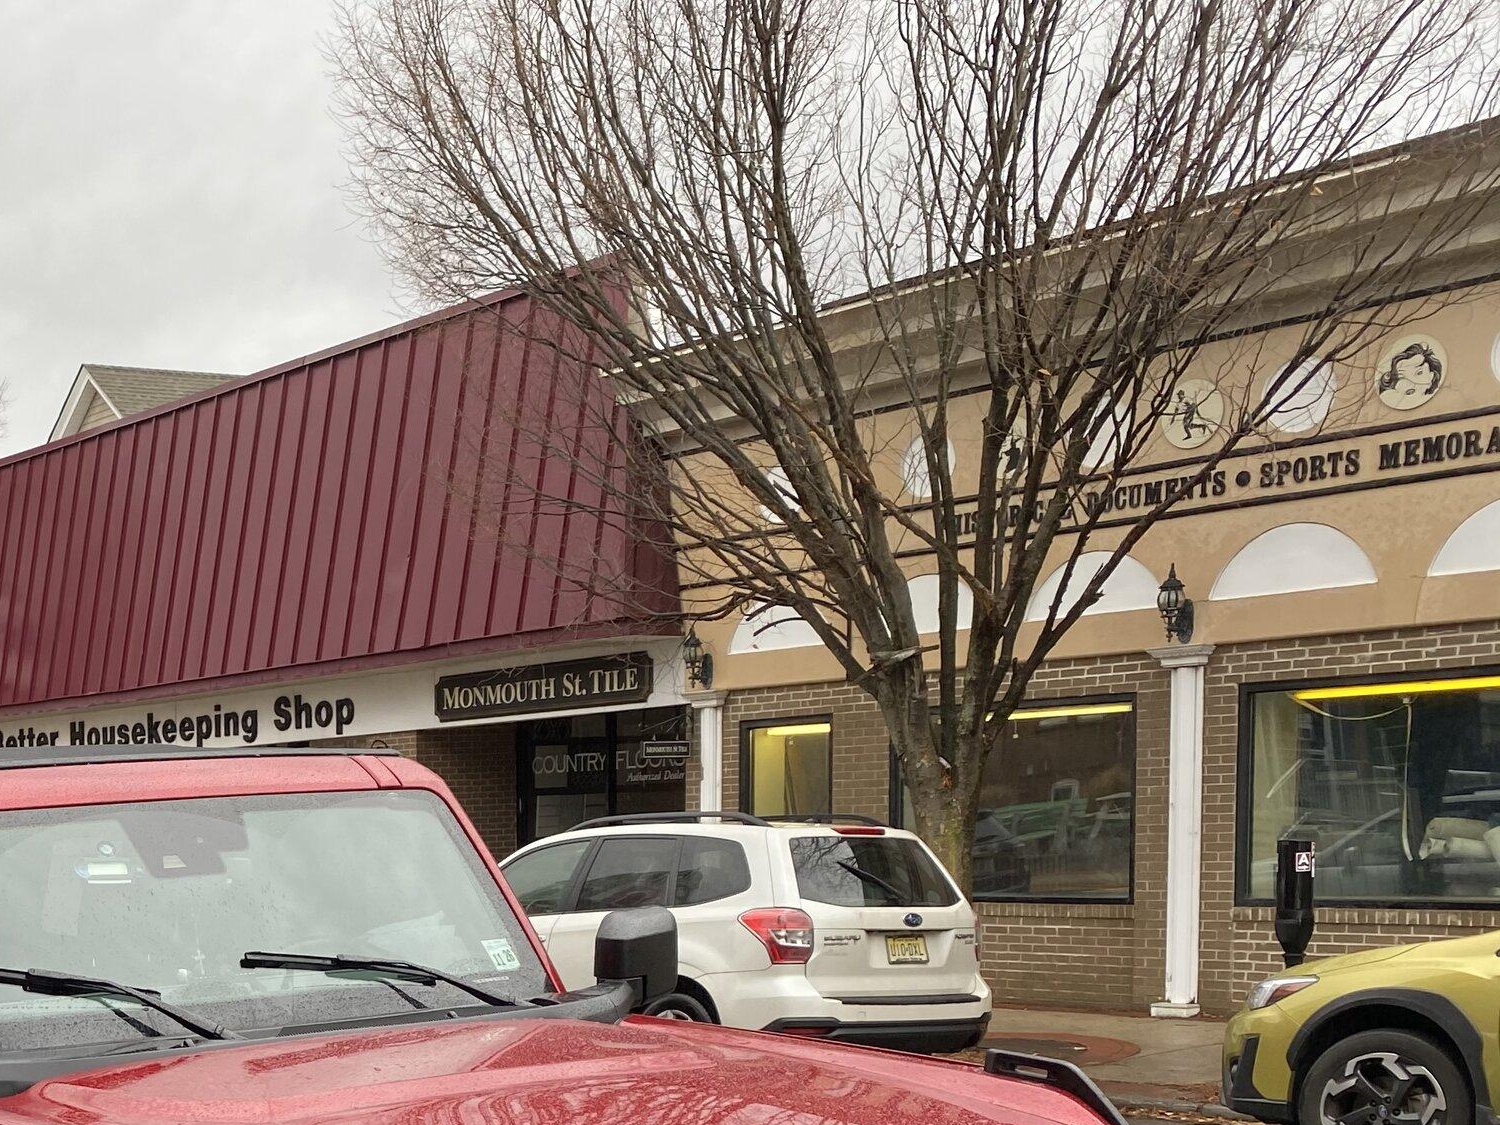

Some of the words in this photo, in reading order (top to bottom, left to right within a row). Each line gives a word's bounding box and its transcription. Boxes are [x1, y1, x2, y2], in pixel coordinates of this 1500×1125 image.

[1260, 449, 1360, 488] SPORTS
[443, 677, 556, 710] MONMOUTH
[562, 672, 587, 698] St.
[589, 667, 639, 695] TILE
[69, 703, 258, 748] Housekeeping
[273, 694, 355, 735] Shop
[532, 752, 606, 775] COUNTRY
[1298, 853, 1309, 866] A
